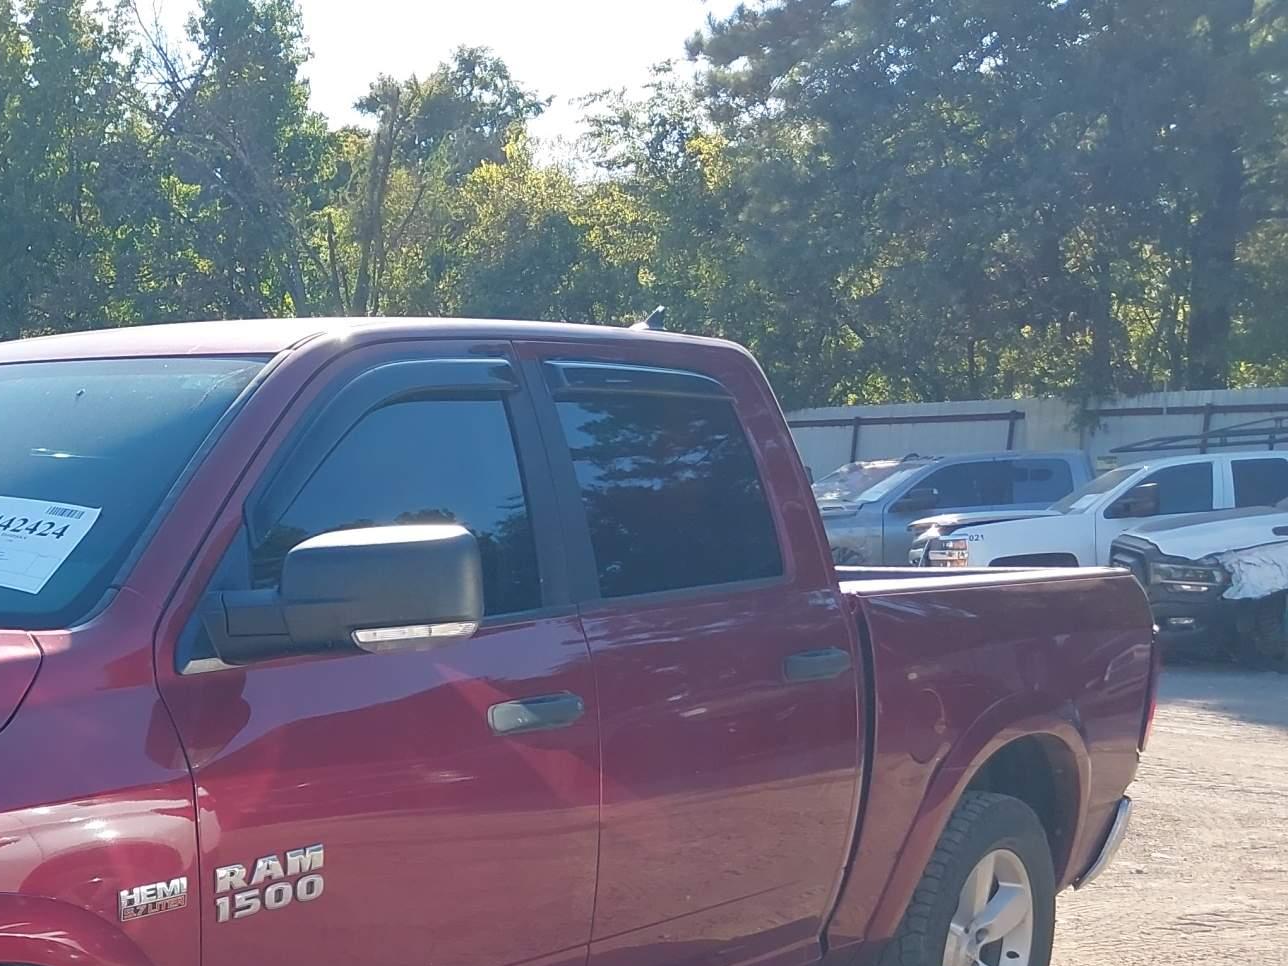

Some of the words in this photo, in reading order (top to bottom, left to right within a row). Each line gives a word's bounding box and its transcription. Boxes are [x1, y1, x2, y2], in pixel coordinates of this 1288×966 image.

[120, 877, 187, 908] HEMI
[215, 843, 325, 893] RAM
[215, 874, 325, 923] 1500
